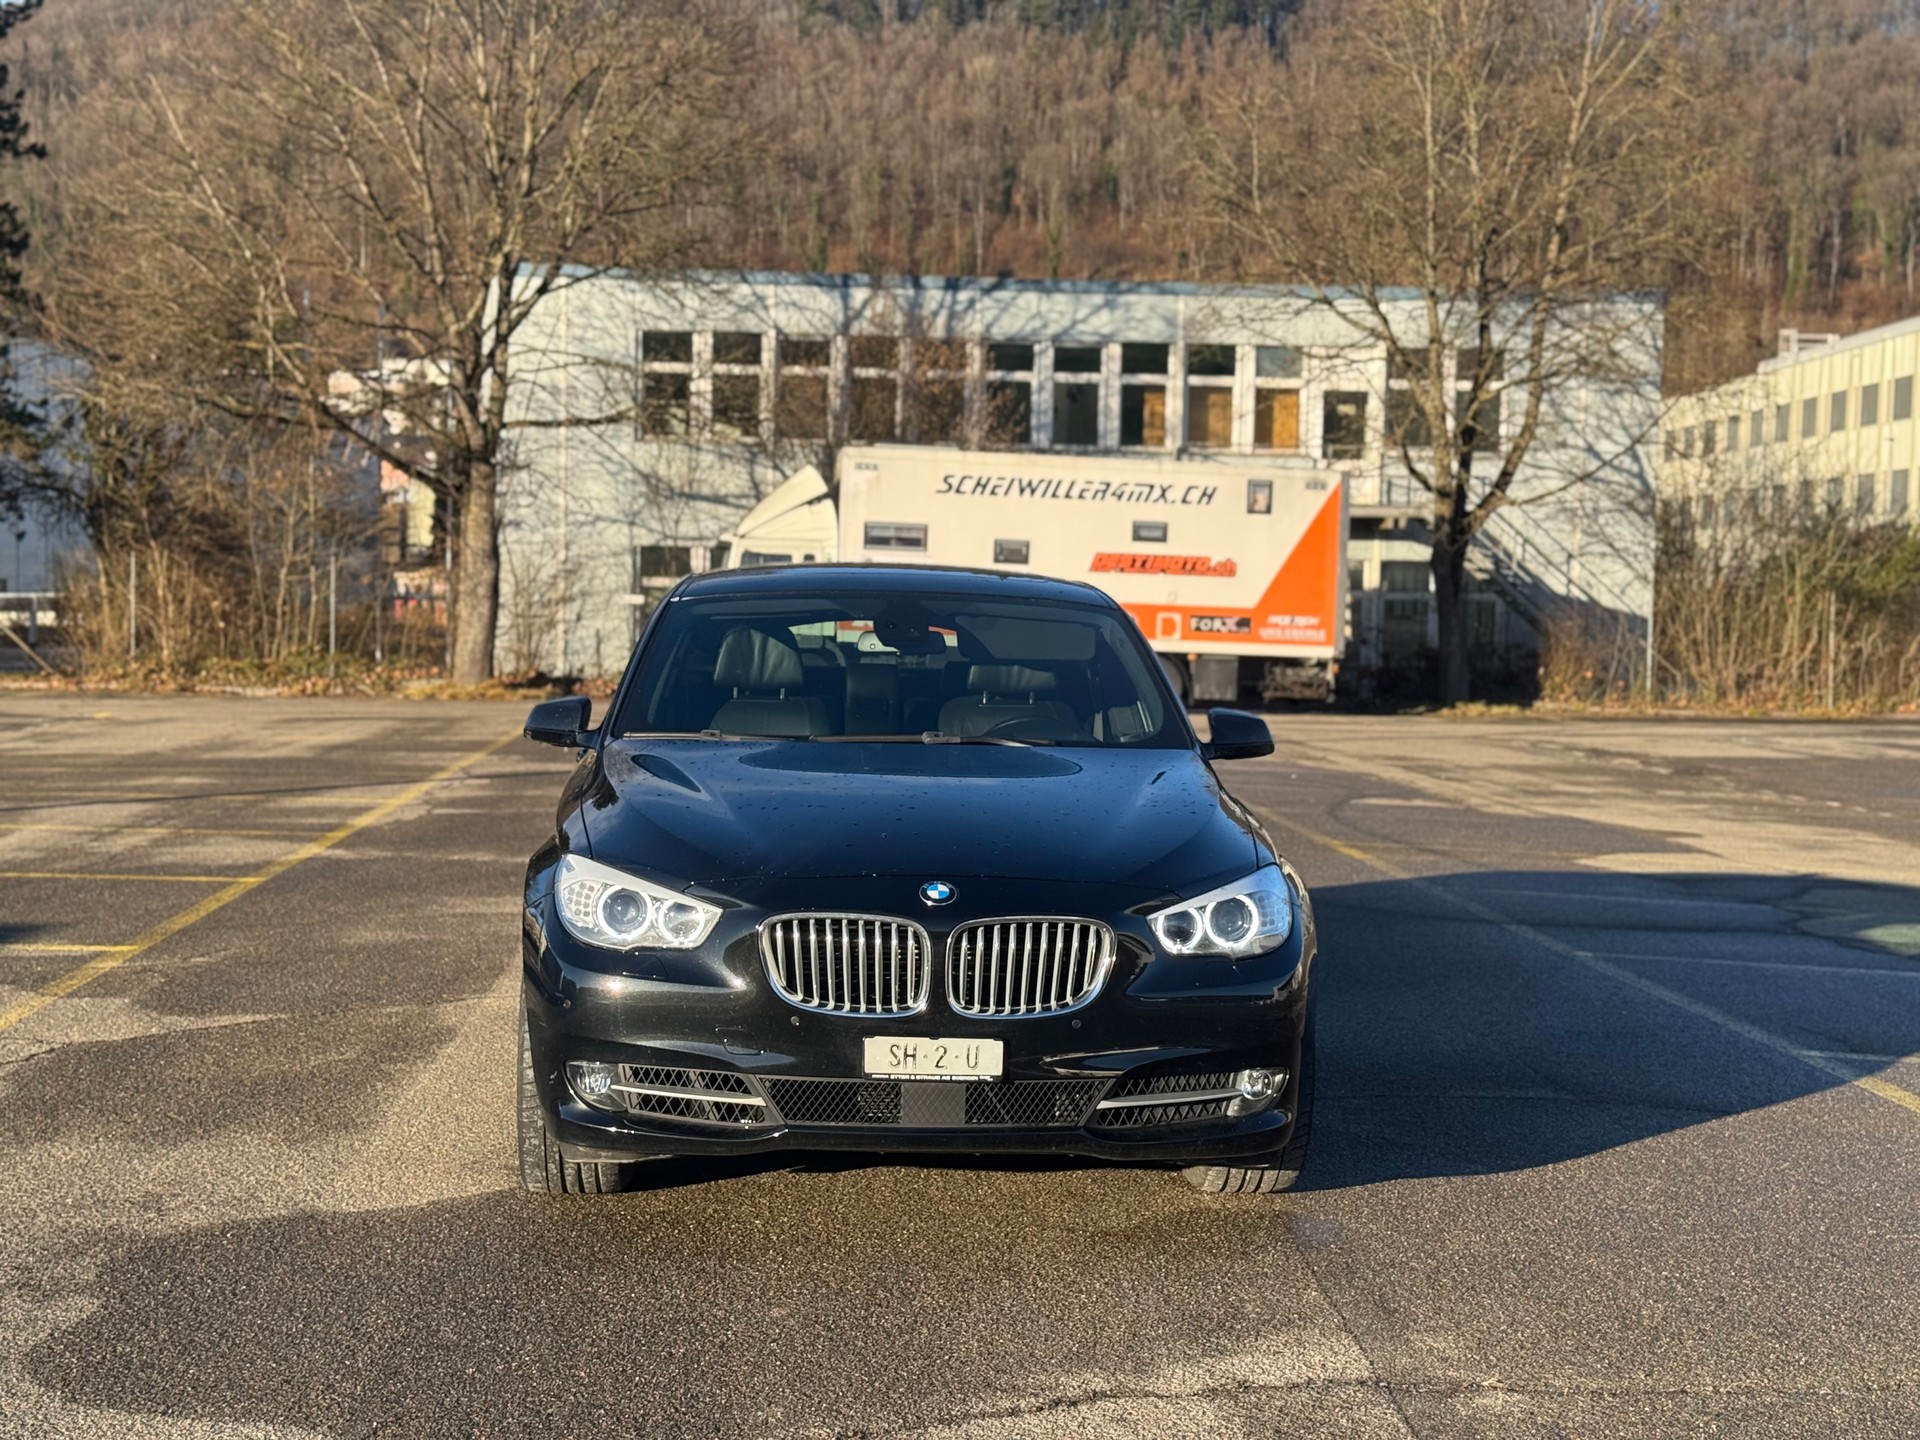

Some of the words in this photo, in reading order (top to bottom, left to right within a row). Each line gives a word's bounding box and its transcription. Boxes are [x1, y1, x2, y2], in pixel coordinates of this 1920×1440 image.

[888, 1044, 918, 1069] SH
[934, 1045, 948, 1069] 2
[966, 1044, 980, 1069] U
